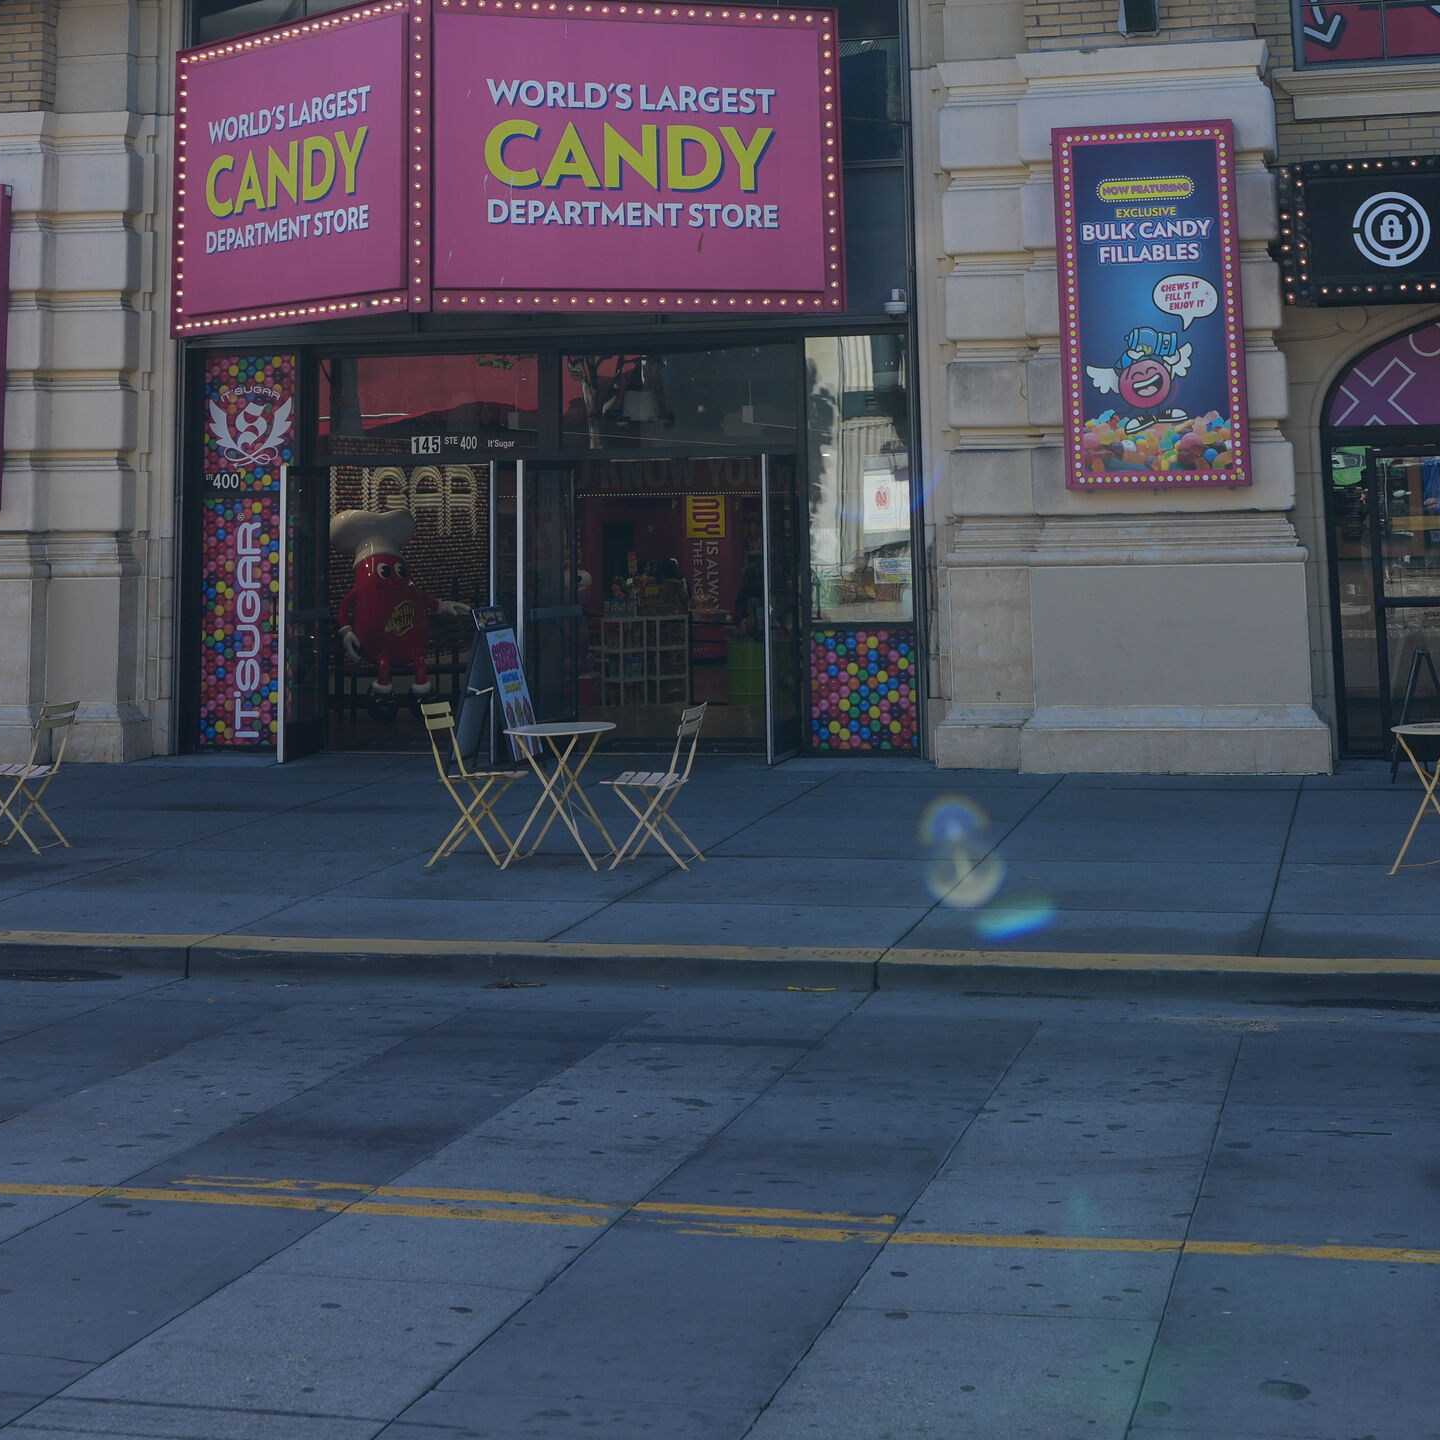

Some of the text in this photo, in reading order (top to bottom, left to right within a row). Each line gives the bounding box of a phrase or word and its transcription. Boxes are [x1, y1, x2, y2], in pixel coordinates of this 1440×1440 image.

[486, 78, 776, 115] WORLD'S LARGEST
[208, 84, 371, 145] WORLD'S LARGEST
[484, 119, 775, 193] CANDY
[205, 126, 369, 220] CANDY
[1102, 183, 1189, 195] NOW FEATURING
[486, 200, 780, 230] DEPARTMENT STORE
[1116, 207, 1177, 218] EXCLUSIVE
[205, 204, 370, 255] DEPARTMENT STORE
[1082, 220, 1212, 241] BULK CANDY
[1099, 243, 1201, 263] FILLABLES
[1161, 281, 1199, 292] CHEWS IT
[1165, 292, 1191, 301] FILL IT
[1169, 300, 1204, 310] ENJOY IT
[220, 386, 281, 402] IT'SUGAR
[412, 436, 441, 453] 145
[444, 437, 458, 445] STE
[460, 436, 477, 450] 400
[213, 474, 239, 489] 400
[234, 522, 261, 738] IT'SUGAR
